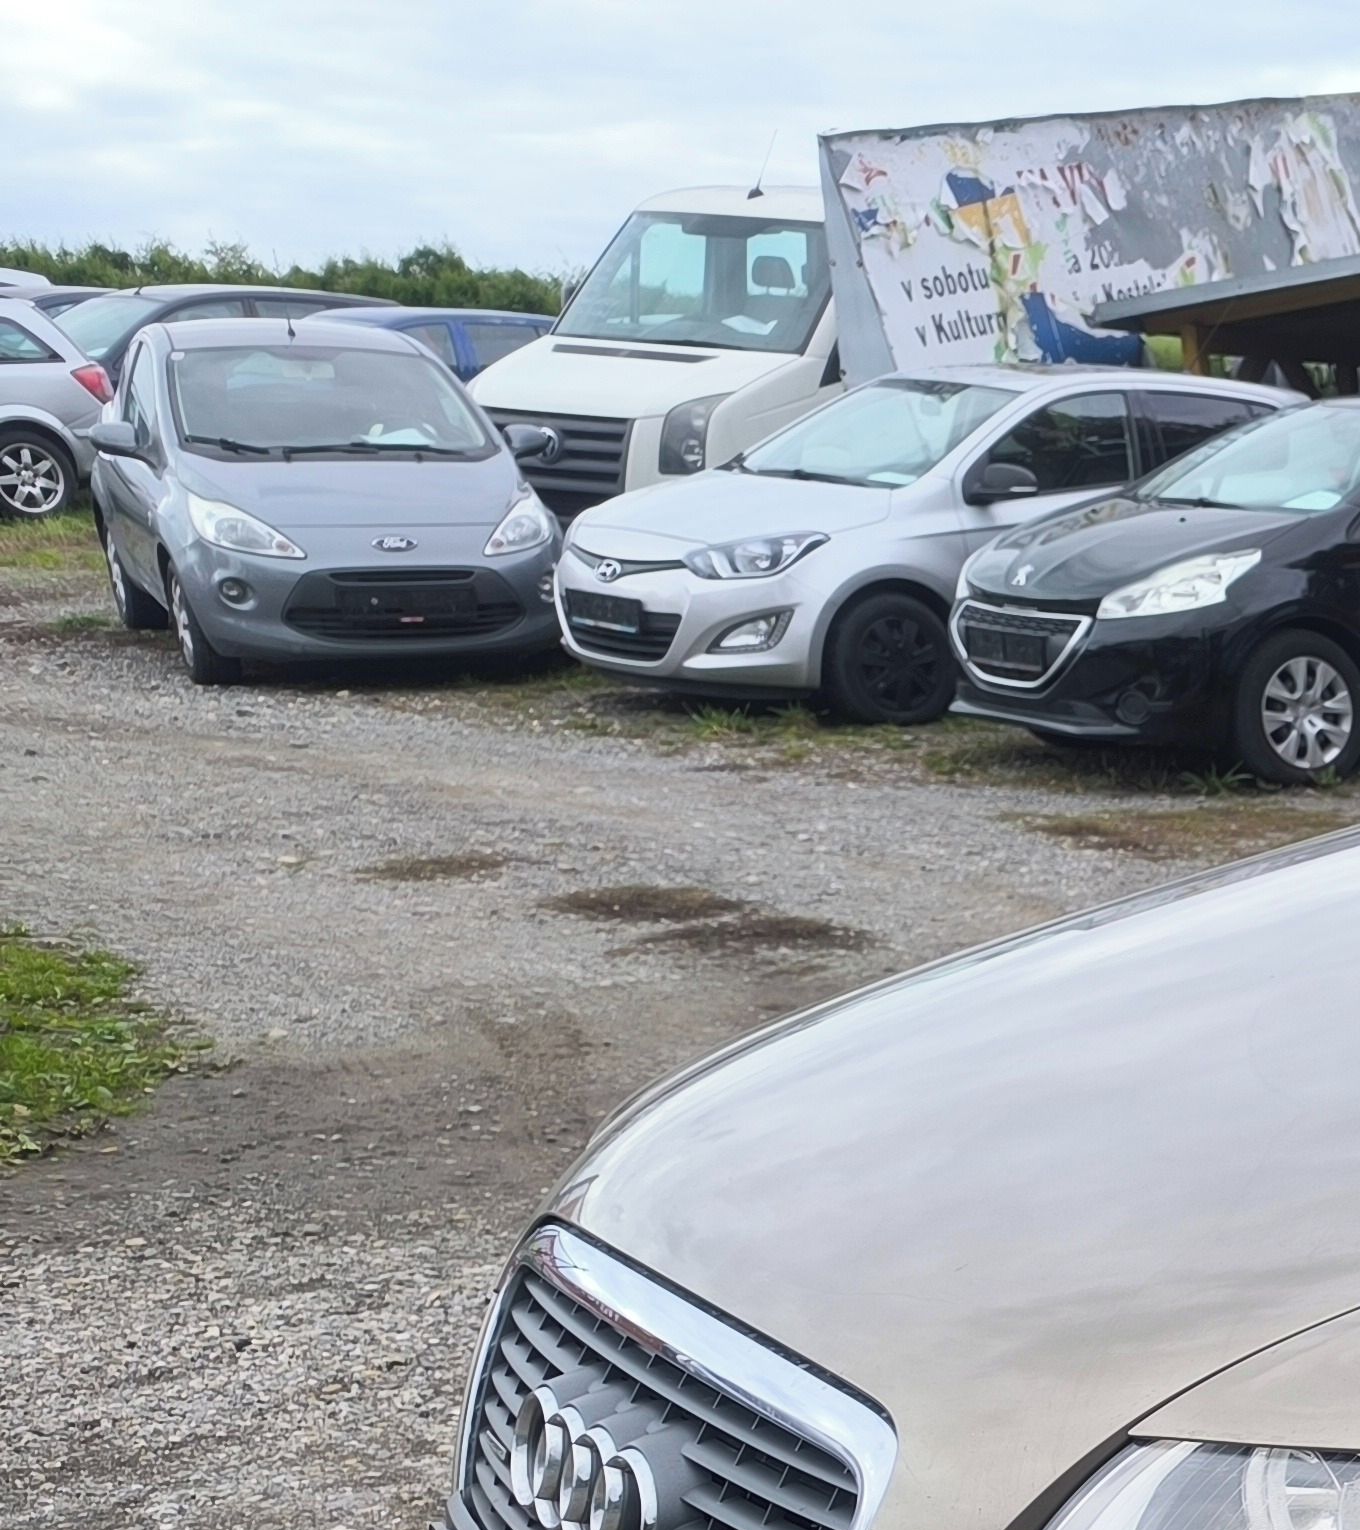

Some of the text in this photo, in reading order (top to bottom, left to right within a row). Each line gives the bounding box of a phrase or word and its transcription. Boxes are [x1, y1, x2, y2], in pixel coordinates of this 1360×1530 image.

[901, 262, 991, 302] v sobotu
[915, 325, 928, 347] v
